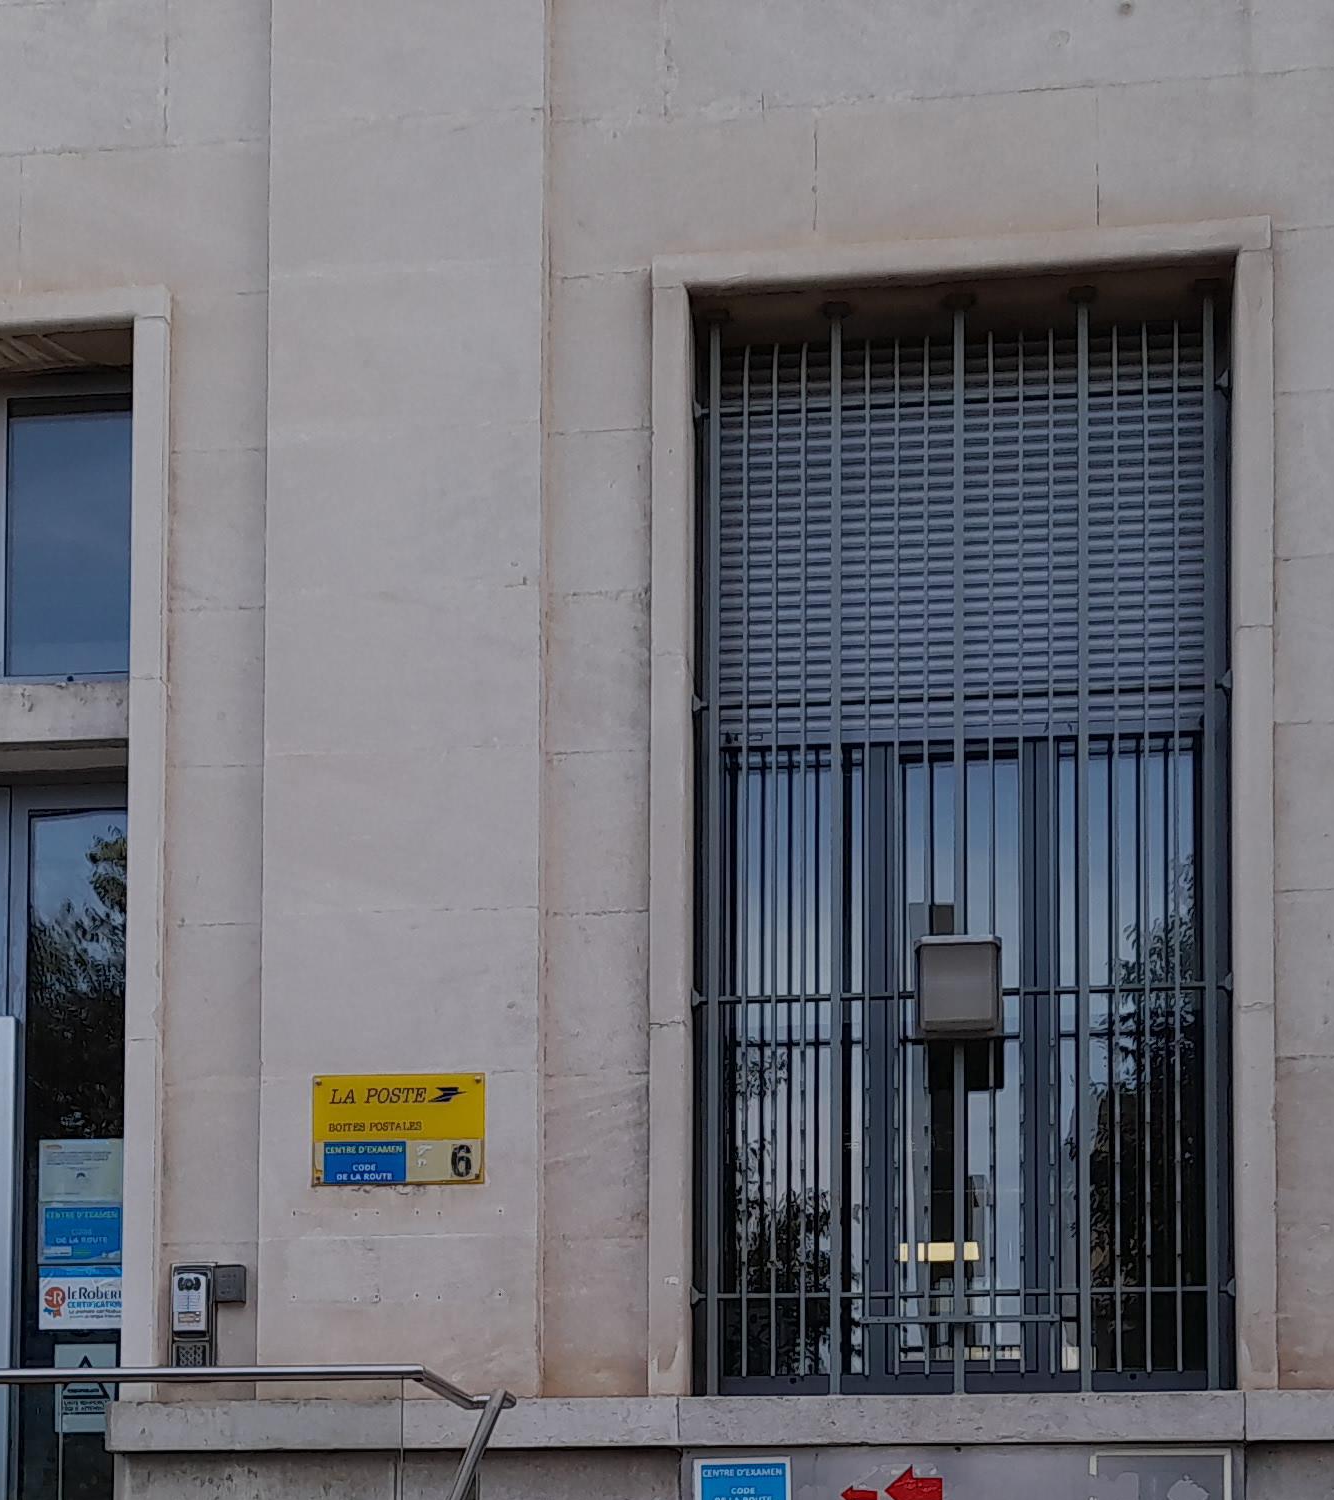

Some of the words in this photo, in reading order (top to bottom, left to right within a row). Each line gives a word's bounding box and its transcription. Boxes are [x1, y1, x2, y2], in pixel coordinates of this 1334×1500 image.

[329, 1088, 356, 1105] LA
[364, 1087, 427, 1104] POSTE
[328, 1122, 365, 1133] BOITES
[369, 1121, 423, 1132] POSTALES
[325, 1146, 356, 1154] CENTRE
[359, 1145, 403, 1154] D'EXAMEN
[451, 1144, 472, 1178] 6
[352, 1163, 377, 1171] CODE
[350, 1173, 361, 1181] LA
[364, 1172, 393, 1181] ROUTE
[702, 1468, 735, 1478] CENTRE
[736, 1467, 782, 1477] D'EXAMEN
[730, 1487, 756, 1495] CODE
